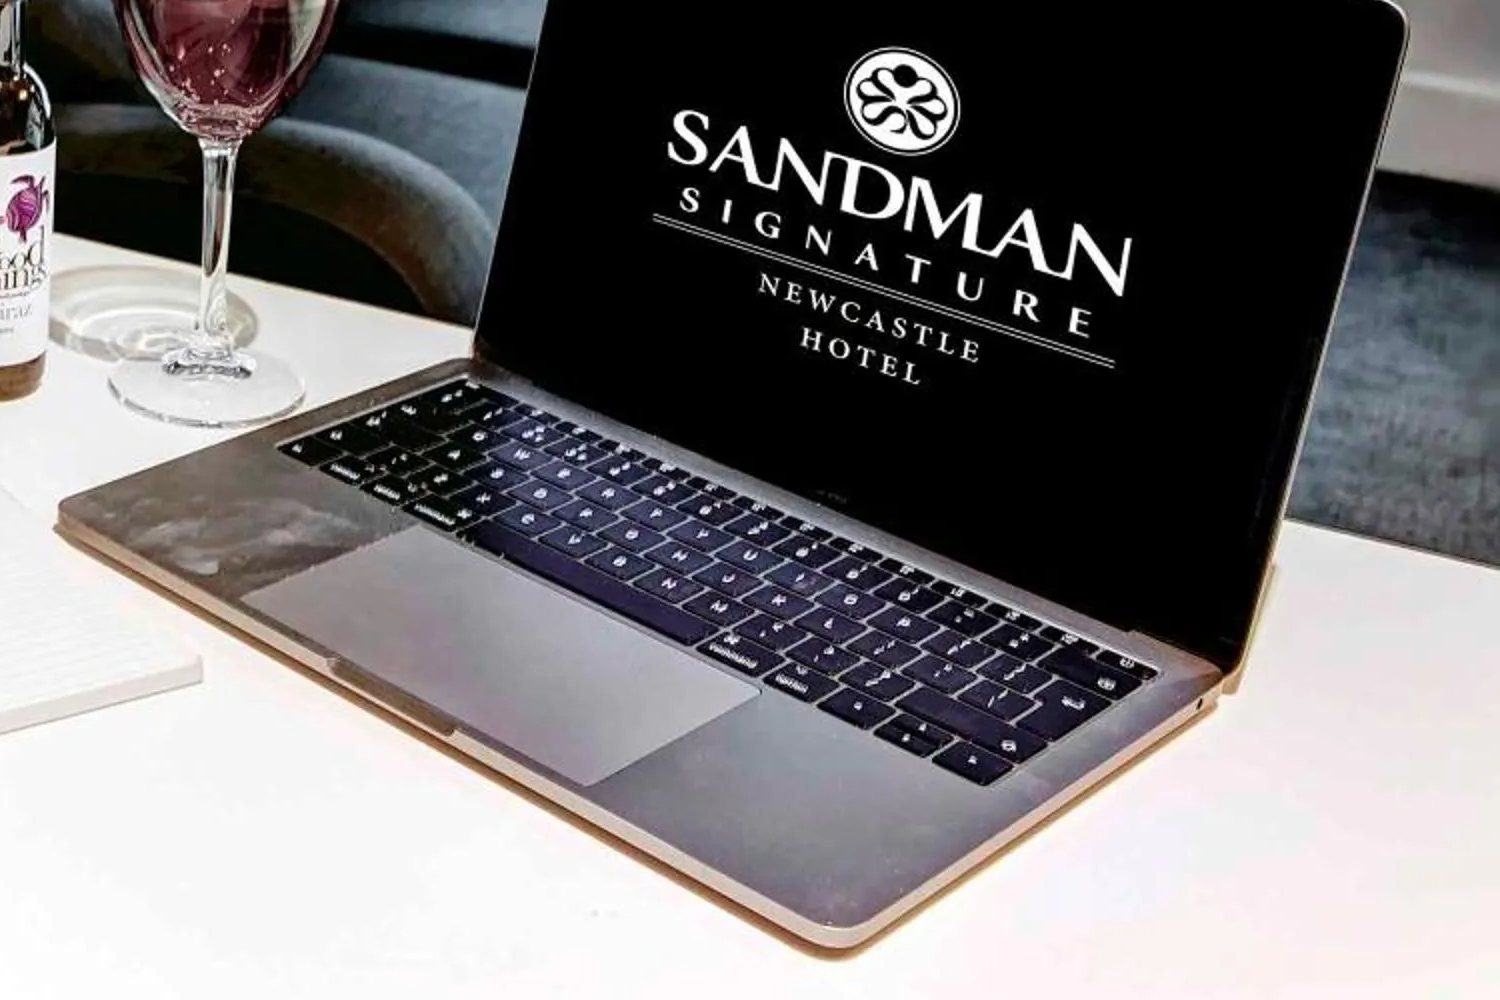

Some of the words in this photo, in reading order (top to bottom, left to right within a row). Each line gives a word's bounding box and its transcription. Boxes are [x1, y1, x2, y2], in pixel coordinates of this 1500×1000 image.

[667, 109, 1133, 297] SANDMAN
[679, 187, 1092, 339] SIGNATURE
[758, 273, 980, 363] NEWCASTLE
[800, 327, 921, 385] HOTEL
